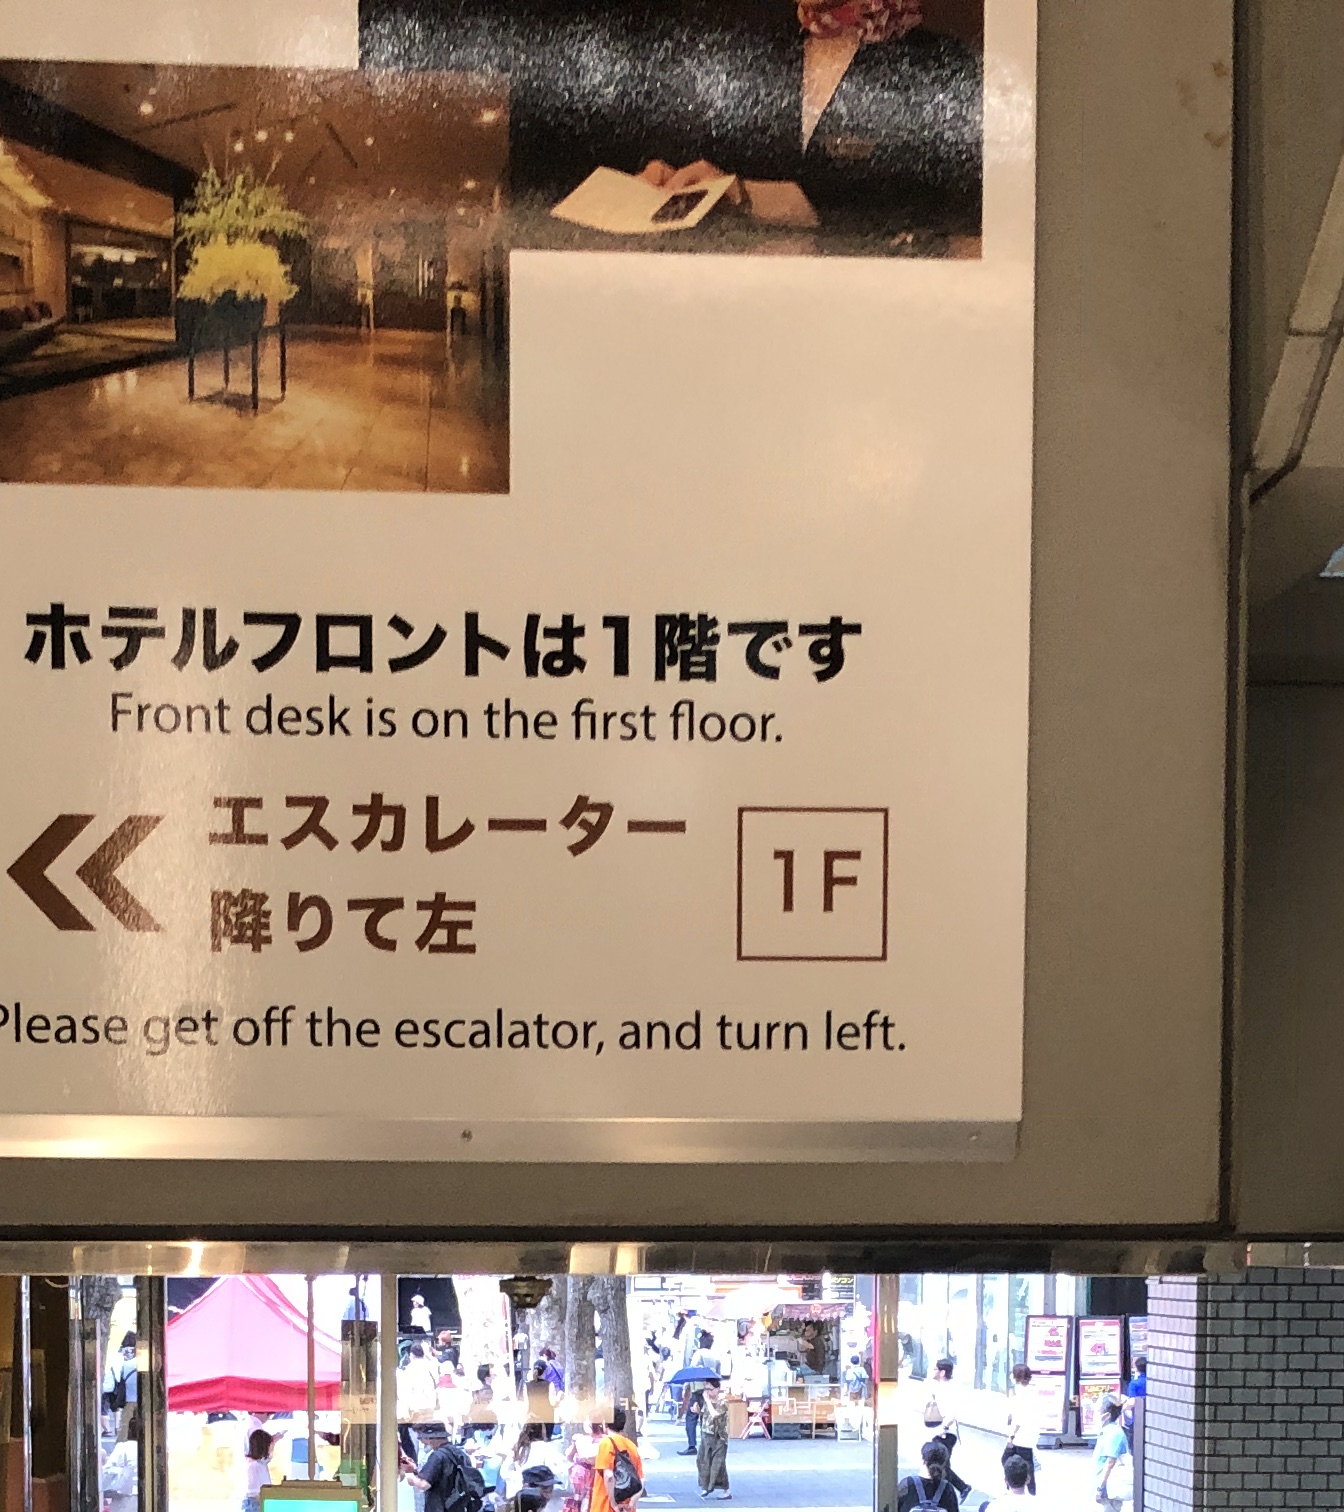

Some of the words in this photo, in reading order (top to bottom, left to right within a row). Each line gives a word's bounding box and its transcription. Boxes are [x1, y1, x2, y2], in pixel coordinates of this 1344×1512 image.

[23, 601, 863, 684] ホテルフロントは1階です
[111, 690, 232, 737] Front
[246, 691, 353, 738] desk
[366, 695, 397, 739] is
[411, 706, 468, 739] on
[483, 696, 558, 741] the
[571, 696, 657, 742] first
[669, 698, 784, 744] floor.
[208, 792, 688, 857] エスカレーター
[772, 848, 862, 914] 1F
[210, 889, 478, 956] 降りて左
[144, 1008, 219, 1057] get
[232, 1004, 297, 1048] off
[305, 1006, 381, 1049] the
[394, 1008, 605, 1057] escalator,
[618, 1009, 702, 1051] and
[715, 1014, 809, 1052] turn
[824, 1009, 906, 1052] left.
